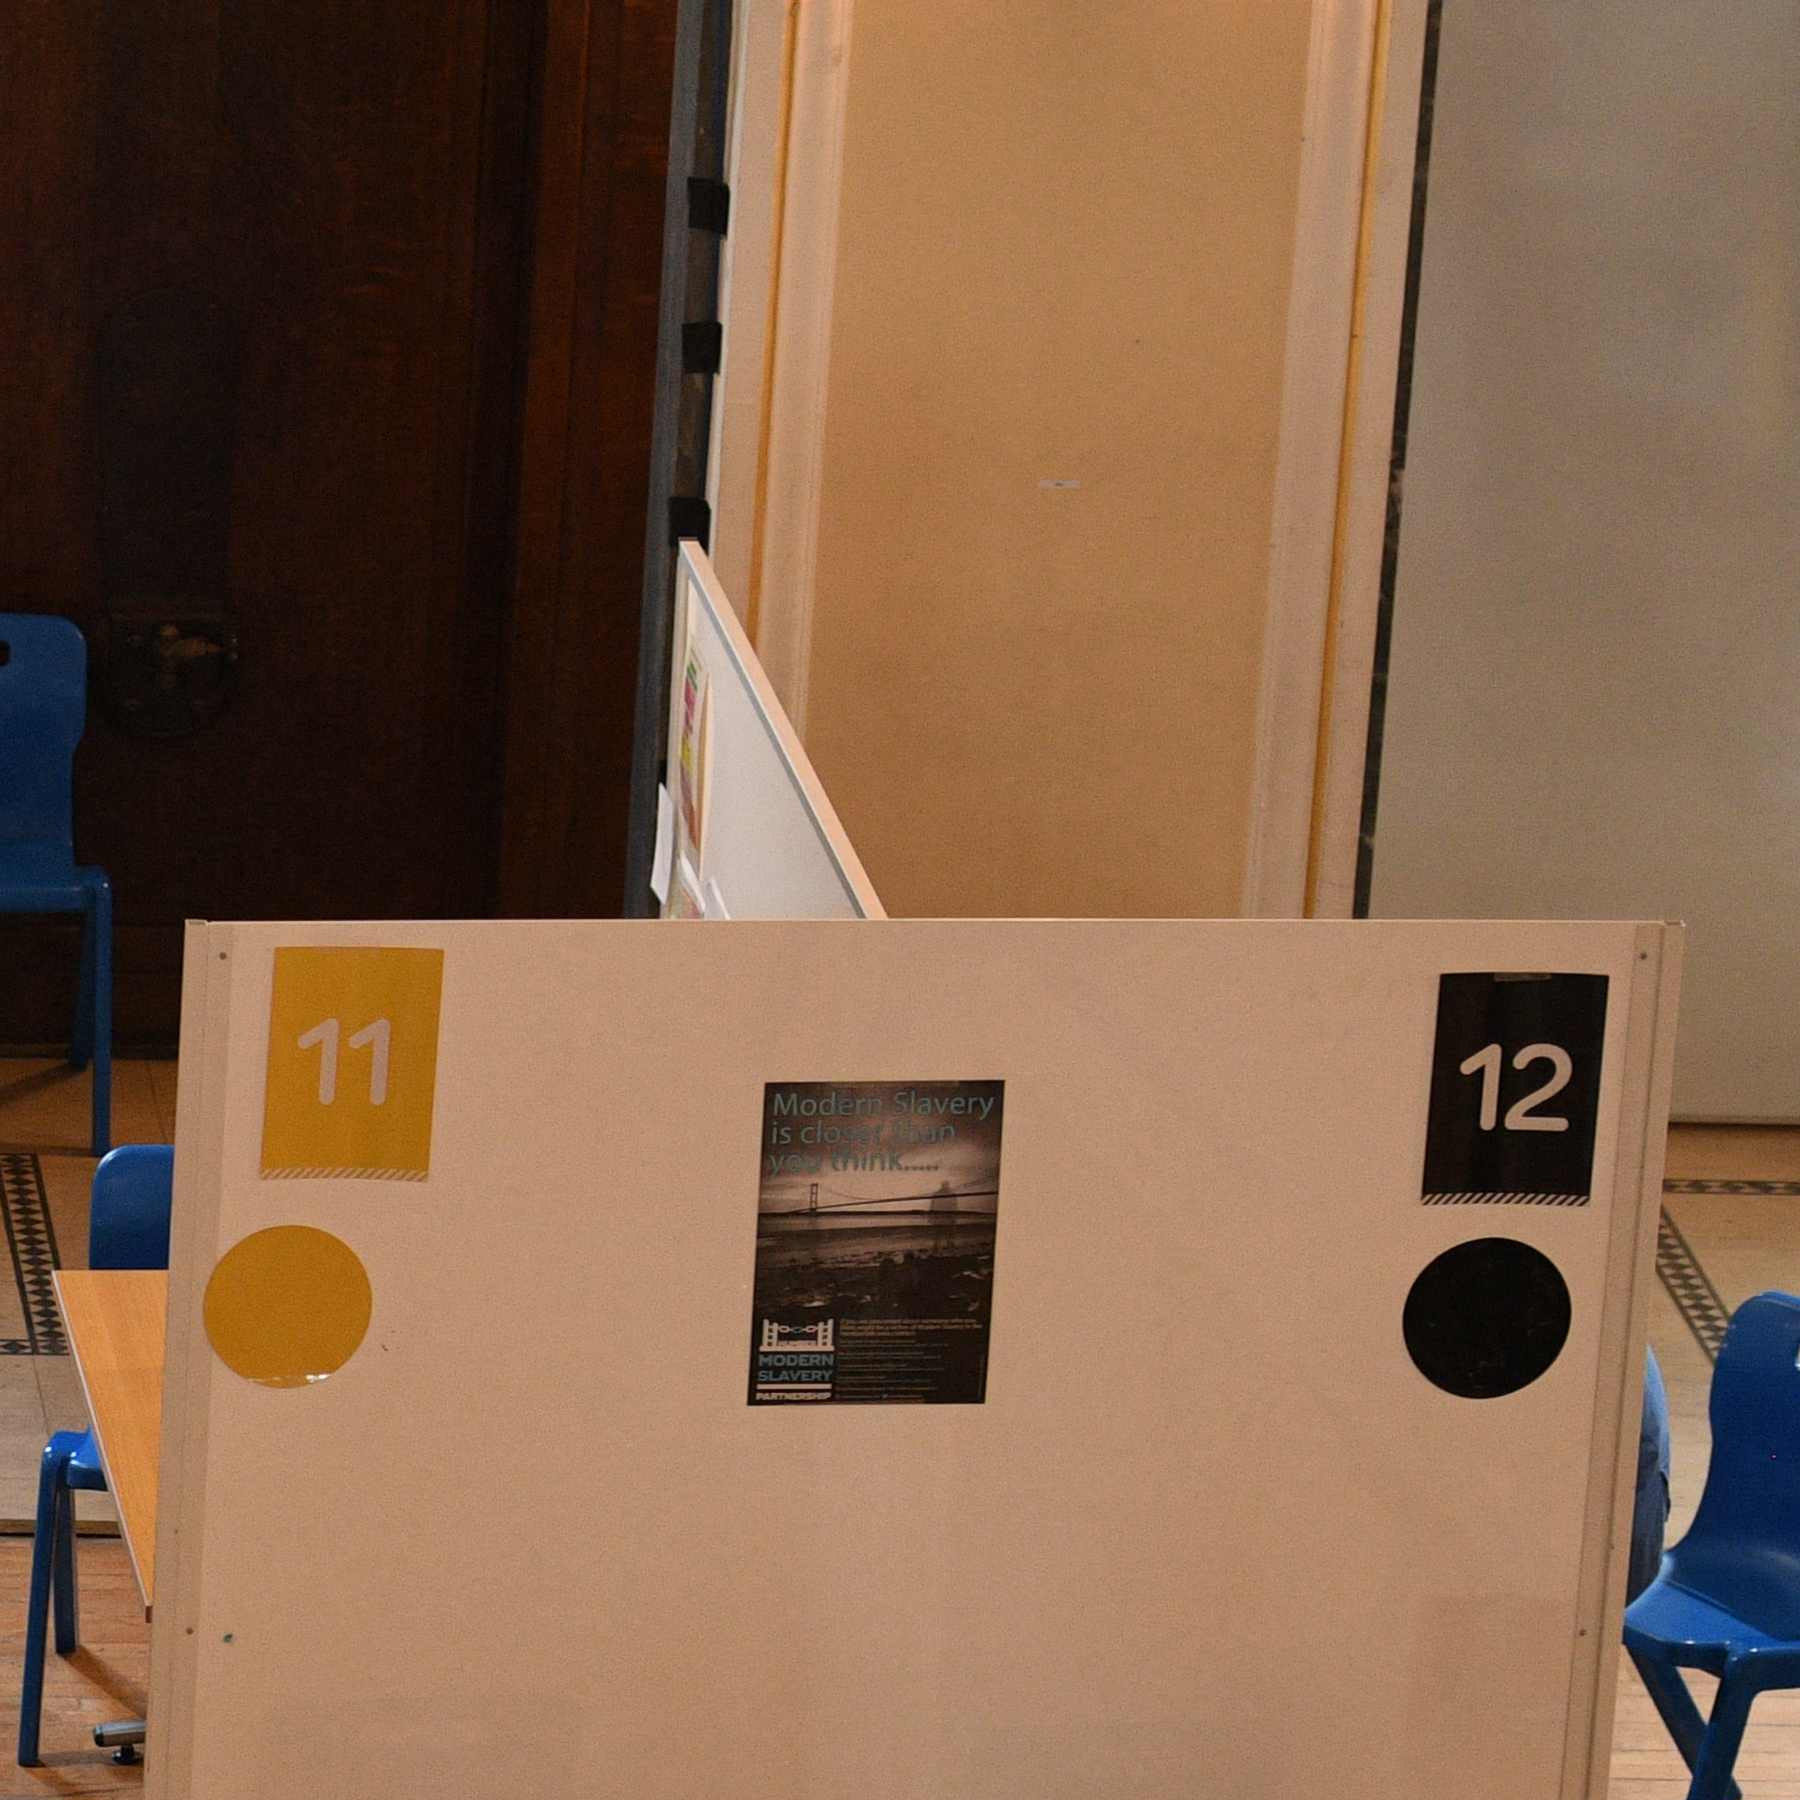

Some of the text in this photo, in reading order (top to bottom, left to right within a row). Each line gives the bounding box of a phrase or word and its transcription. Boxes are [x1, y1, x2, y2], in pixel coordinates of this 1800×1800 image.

[297, 1017, 391, 1107] 11
[1459, 1042, 1573, 1132] 12
[772, 1089, 996, 1120] Modern Slavery
[771, 1120, 792, 1144] is
[799, 1120, 883, 1145] closer
[767, 1151, 822, 1177] you
[758, 1354, 834, 1367] MODERN
[758, 1370, 833, 1382] SLAVERY
[755, 1391, 832, 1401] PARTNERSHIP
